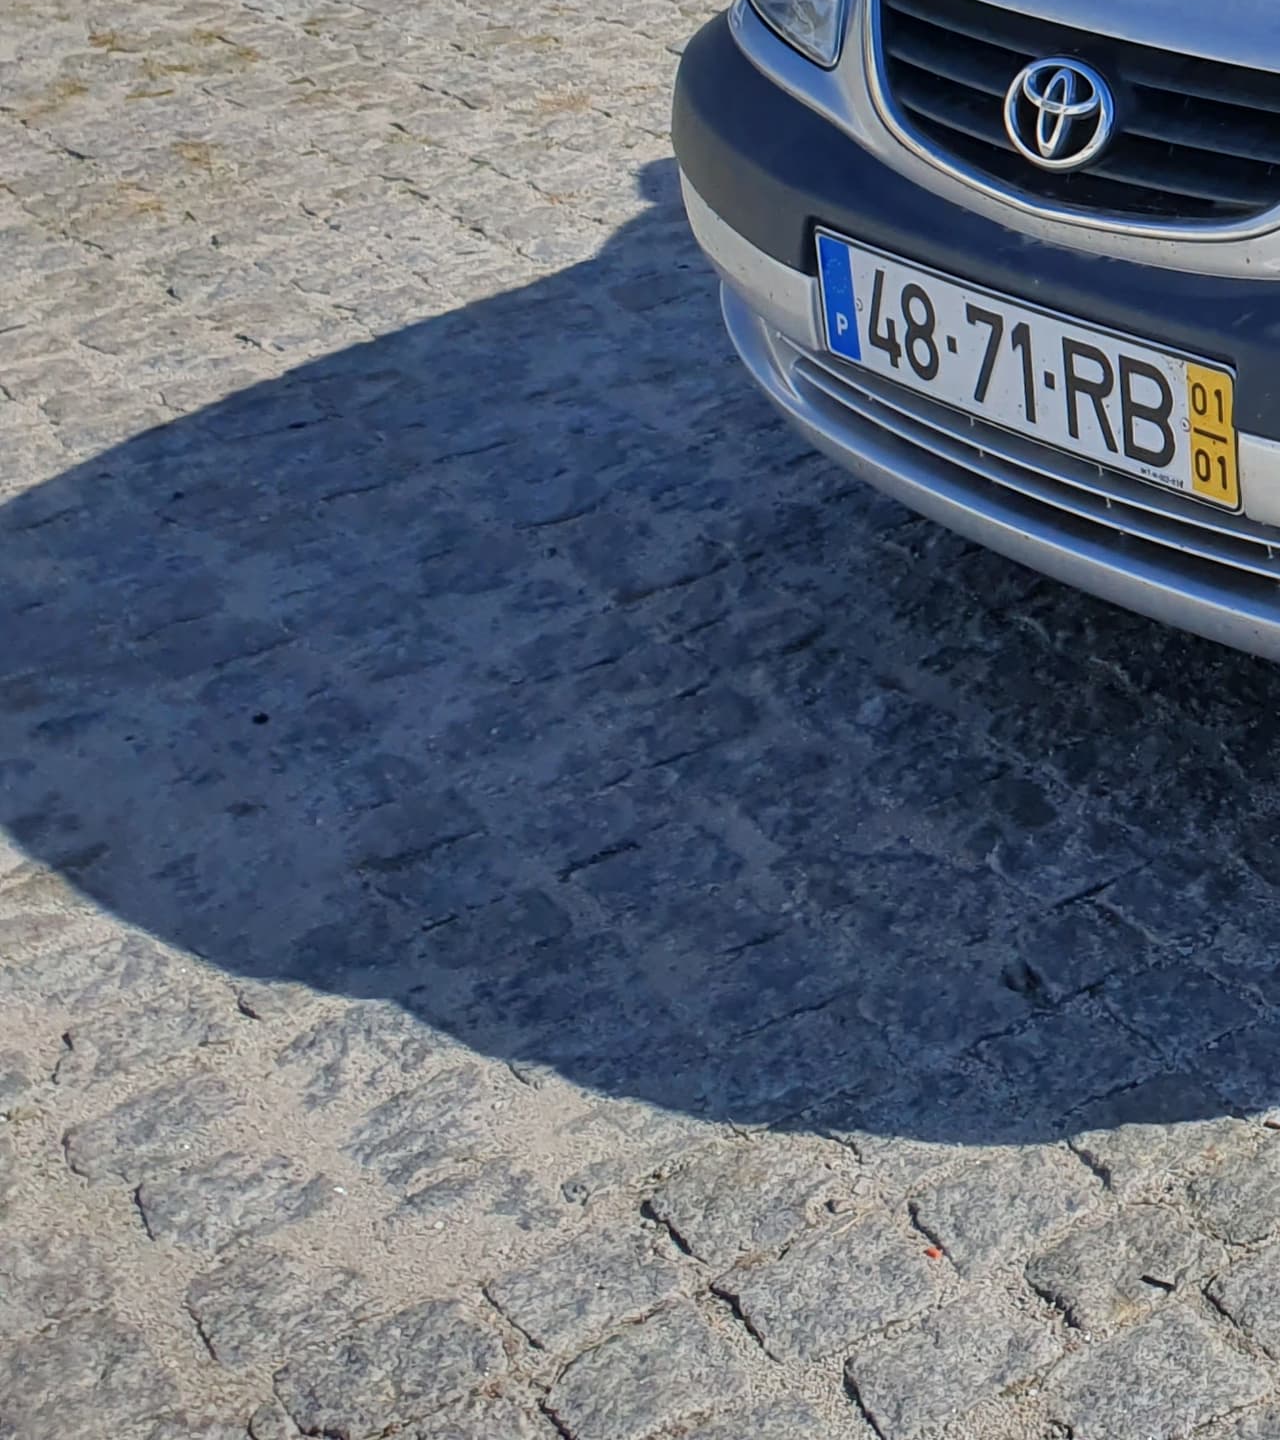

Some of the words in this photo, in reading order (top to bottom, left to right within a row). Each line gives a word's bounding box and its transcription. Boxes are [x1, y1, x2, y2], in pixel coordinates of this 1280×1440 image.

[837, 311, 849, 336] P
[1191, 381, 1224, 424] 01
[1194, 448, 1228, 491] 01
